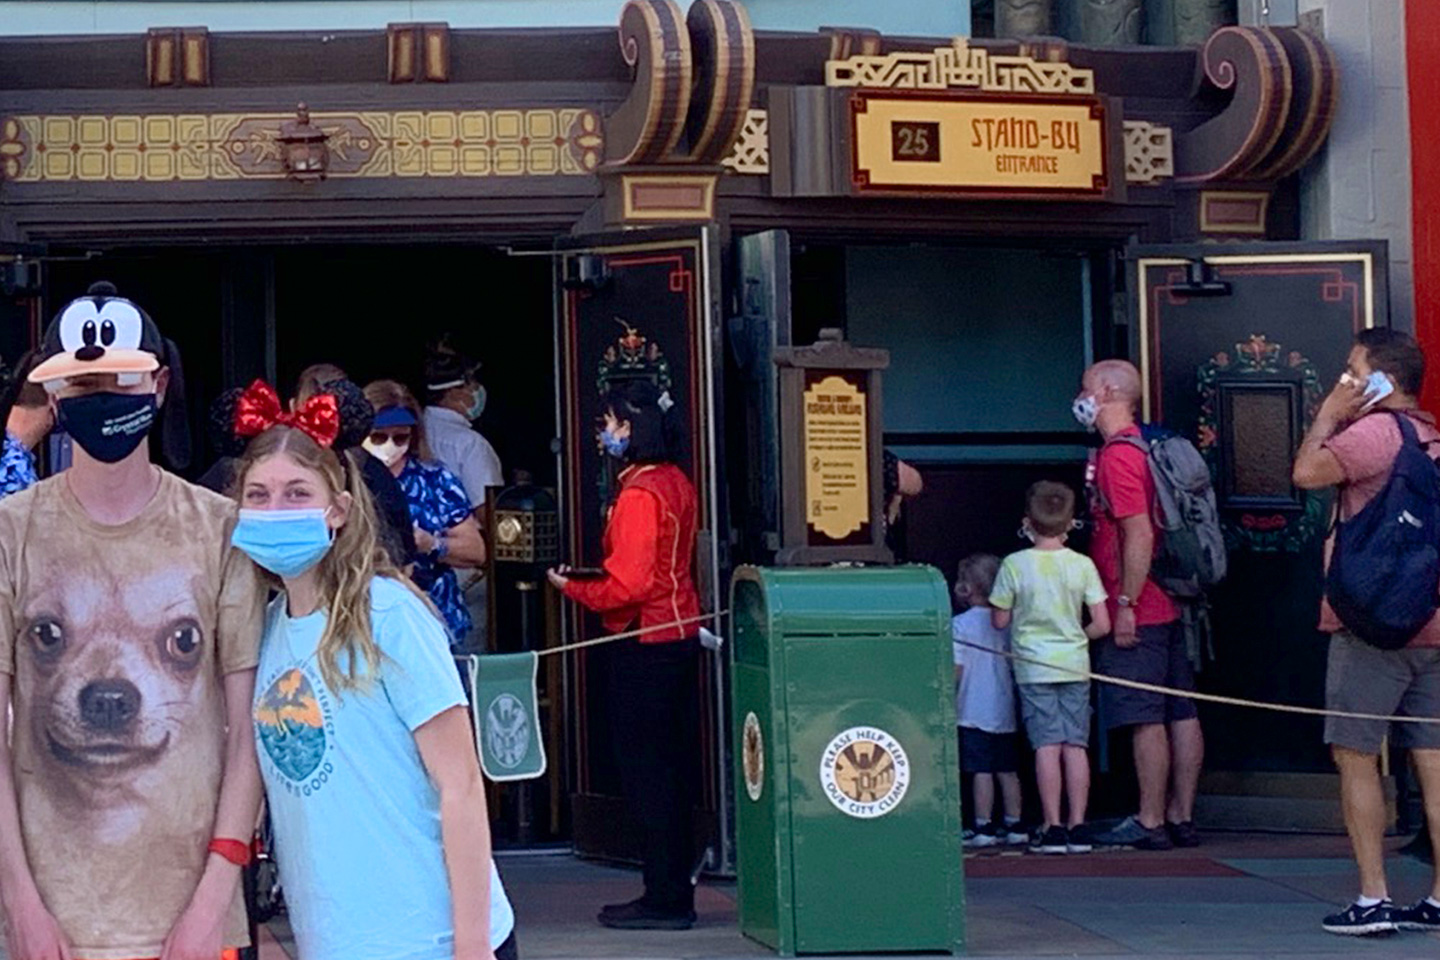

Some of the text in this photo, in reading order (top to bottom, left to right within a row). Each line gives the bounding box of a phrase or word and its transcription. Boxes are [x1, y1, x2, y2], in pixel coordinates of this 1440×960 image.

[897, 126, 929, 156] 25
[971, 116, 1081, 154] STAND-BY
[996, 154, 1058, 174] ENTRANCE
[824, 730, 906, 768] PLEASE HELP KEEP
[302, 761, 334, 797] GOOD
[826, 780, 905, 815] OUR CITY CLEAN
